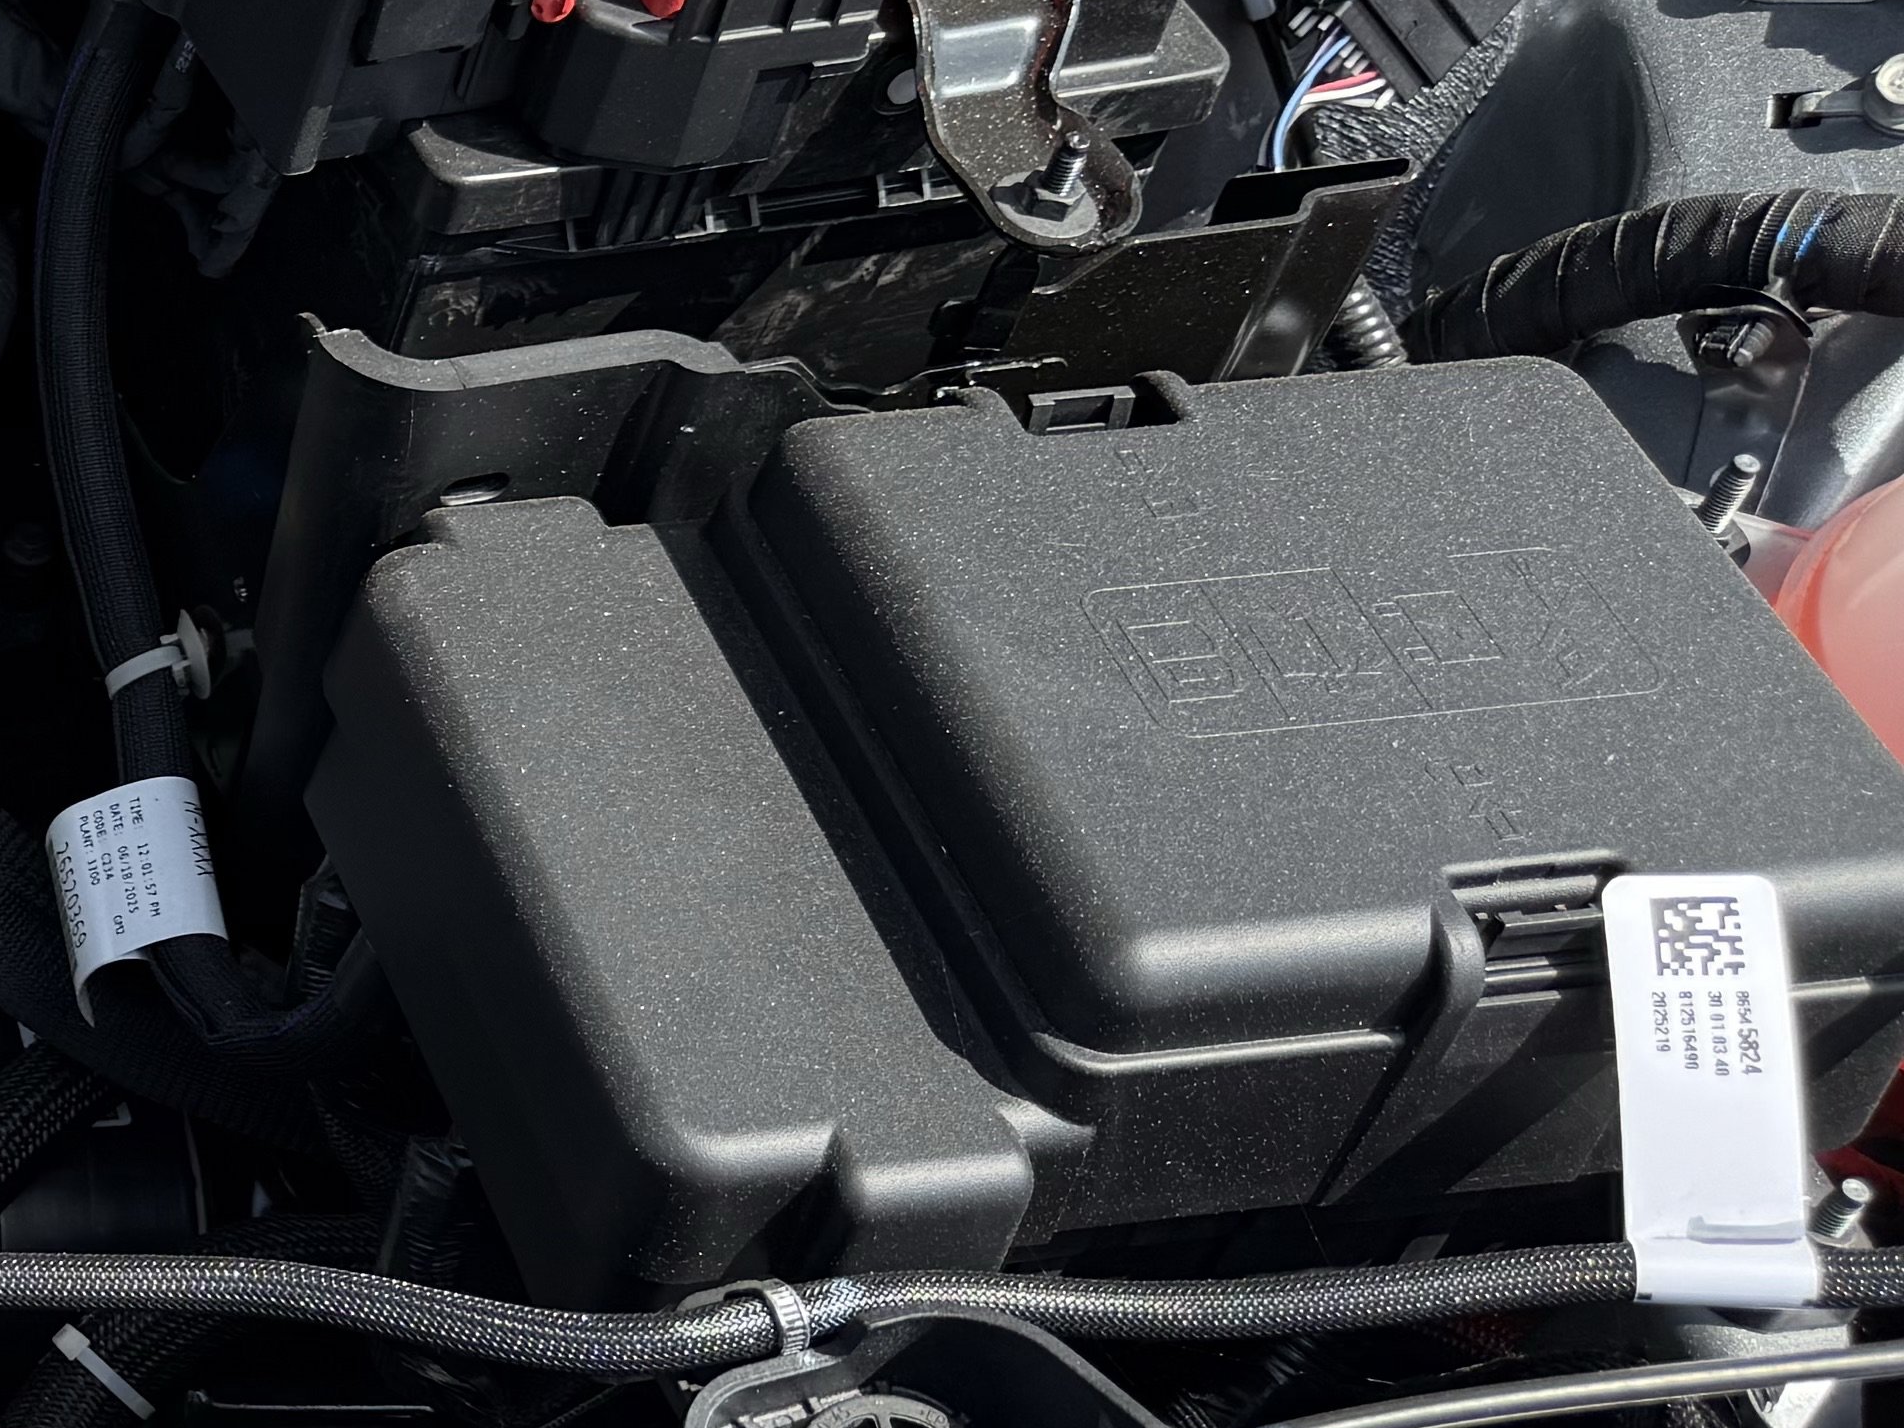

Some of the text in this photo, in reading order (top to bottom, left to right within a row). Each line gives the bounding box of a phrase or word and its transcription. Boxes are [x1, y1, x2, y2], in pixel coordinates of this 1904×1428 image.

[108, 803, 139, 915] DATE: 06/18/2025
[127, 796, 161, 918] TIME: 12:01:57 PM
[1649, 990, 1672, 1054] 2025219
[1676, 990, 1700, 1071] 812516490
